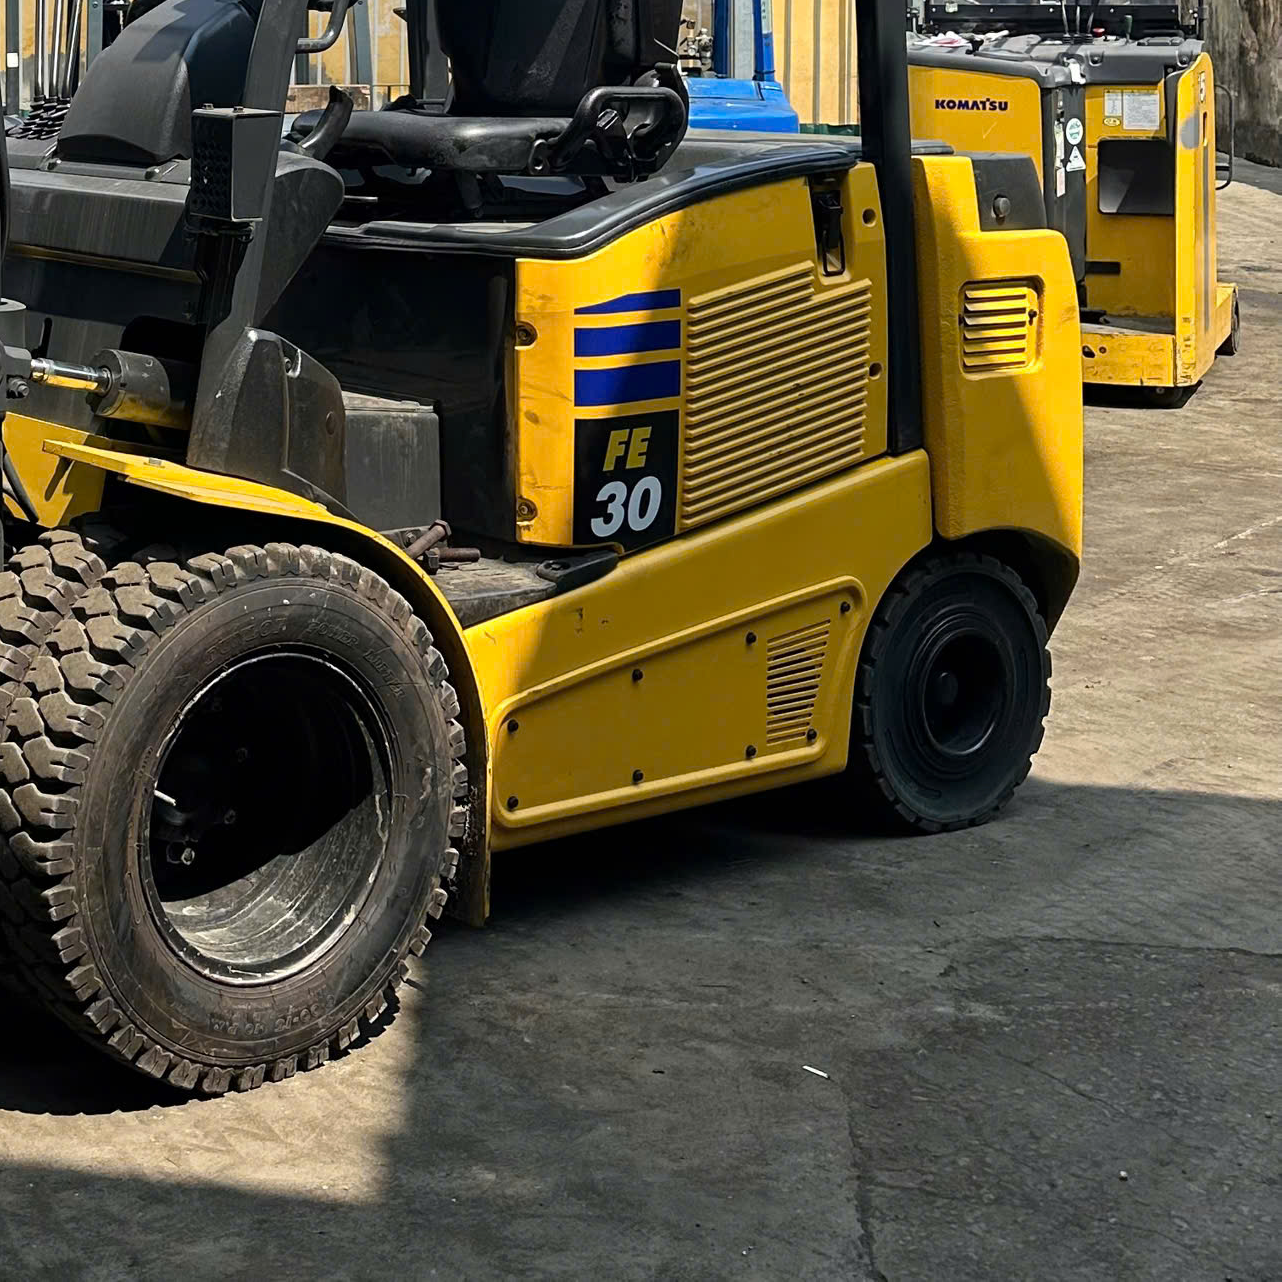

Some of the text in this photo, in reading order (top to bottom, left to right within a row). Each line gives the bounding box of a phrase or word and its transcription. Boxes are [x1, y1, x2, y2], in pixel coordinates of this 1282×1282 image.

[934, 98, 1009, 111] KOMATSU
[603, 426, 652, 471] FE
[590, 475, 662, 538] 30
